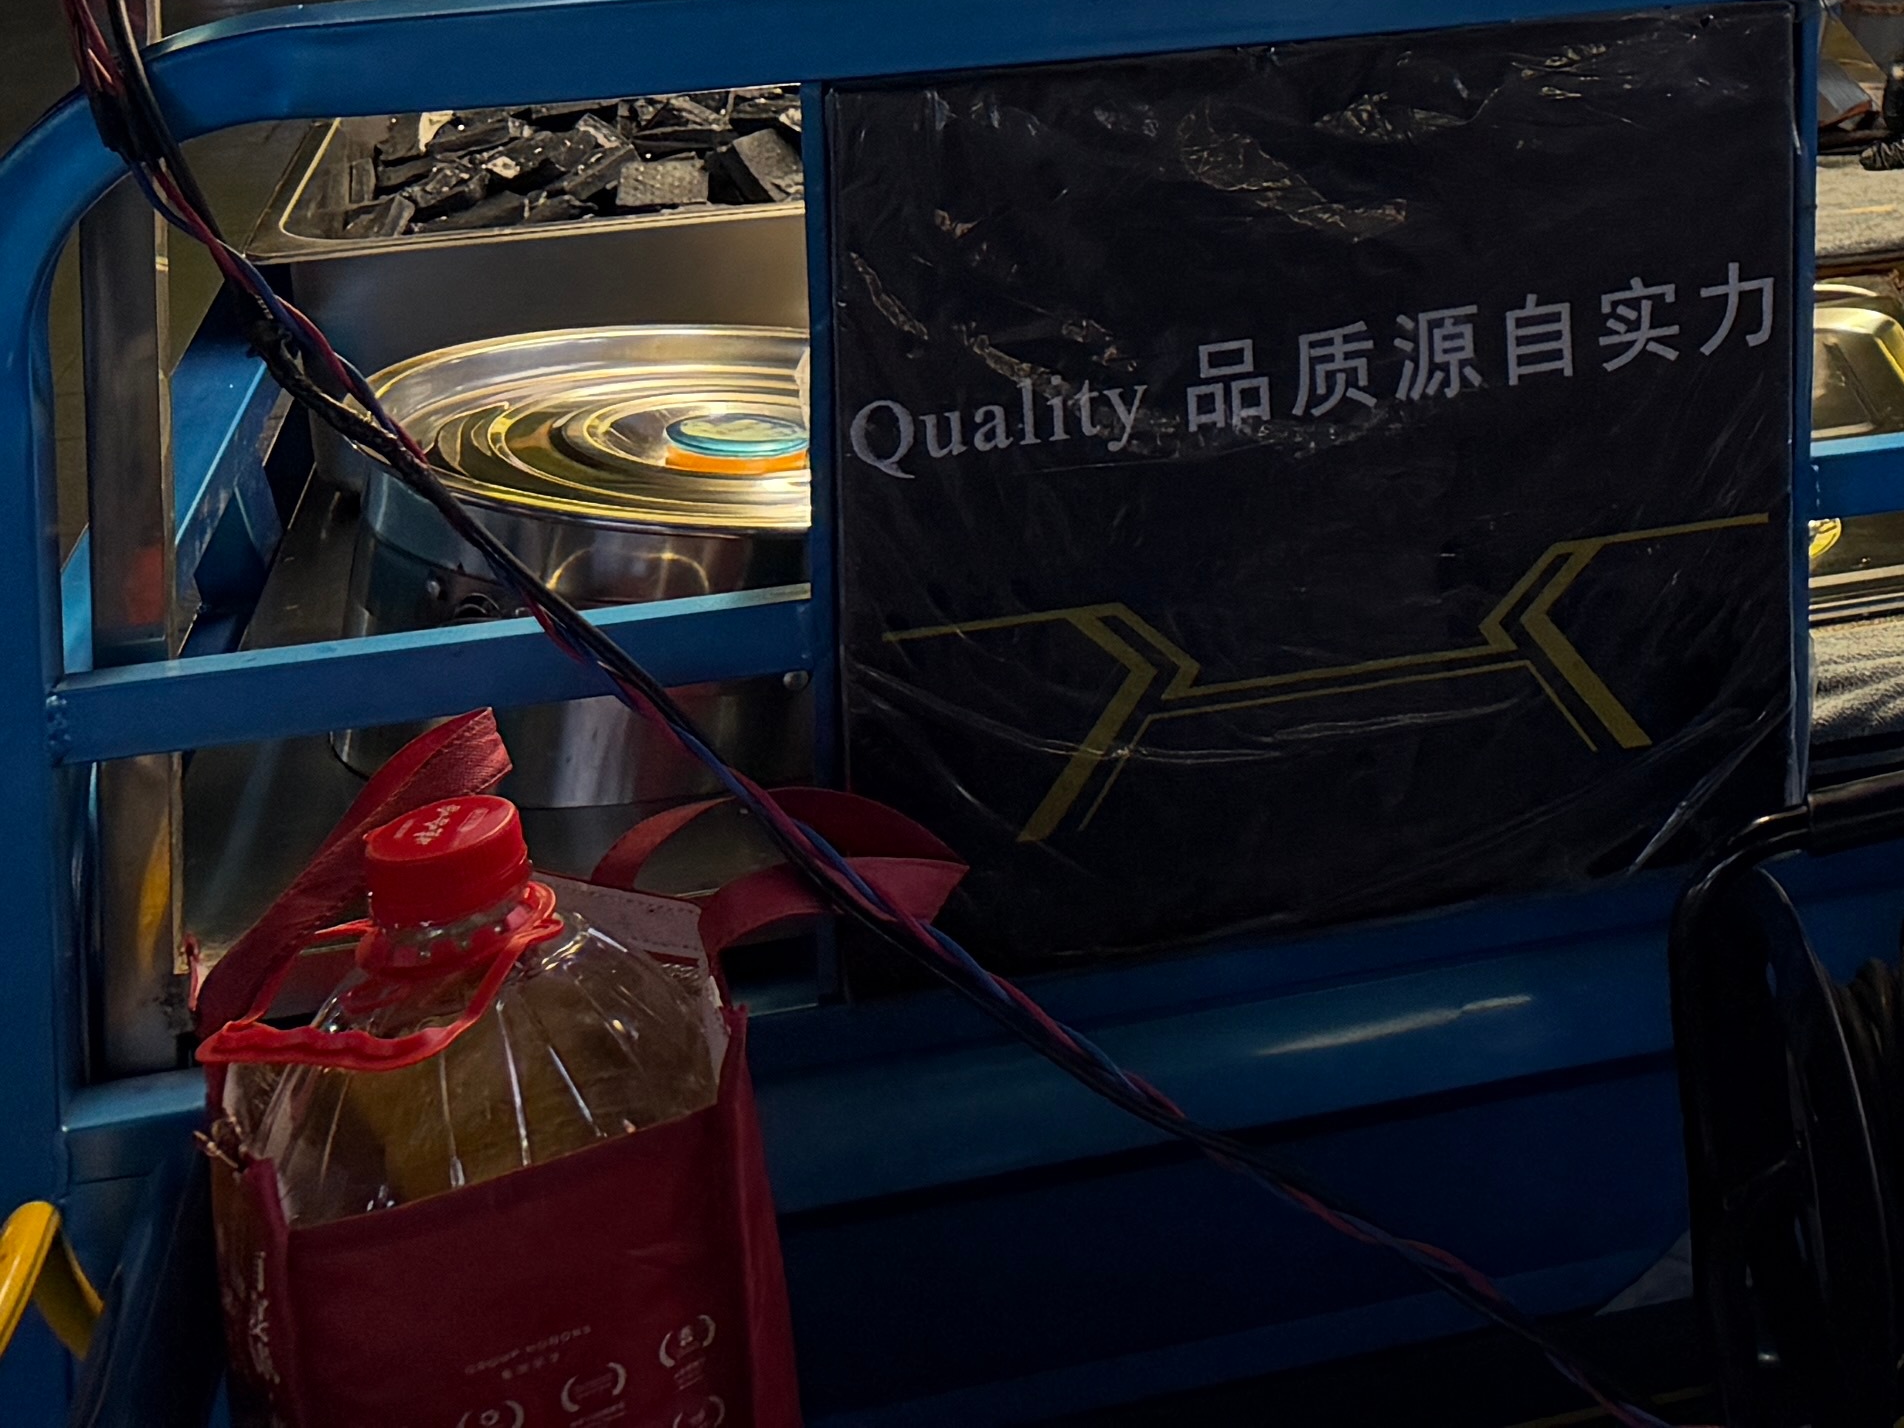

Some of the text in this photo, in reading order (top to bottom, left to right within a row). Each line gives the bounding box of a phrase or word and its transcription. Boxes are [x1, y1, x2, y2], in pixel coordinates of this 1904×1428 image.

[850, 261, 1778, 480] Quality 品质源自实力
